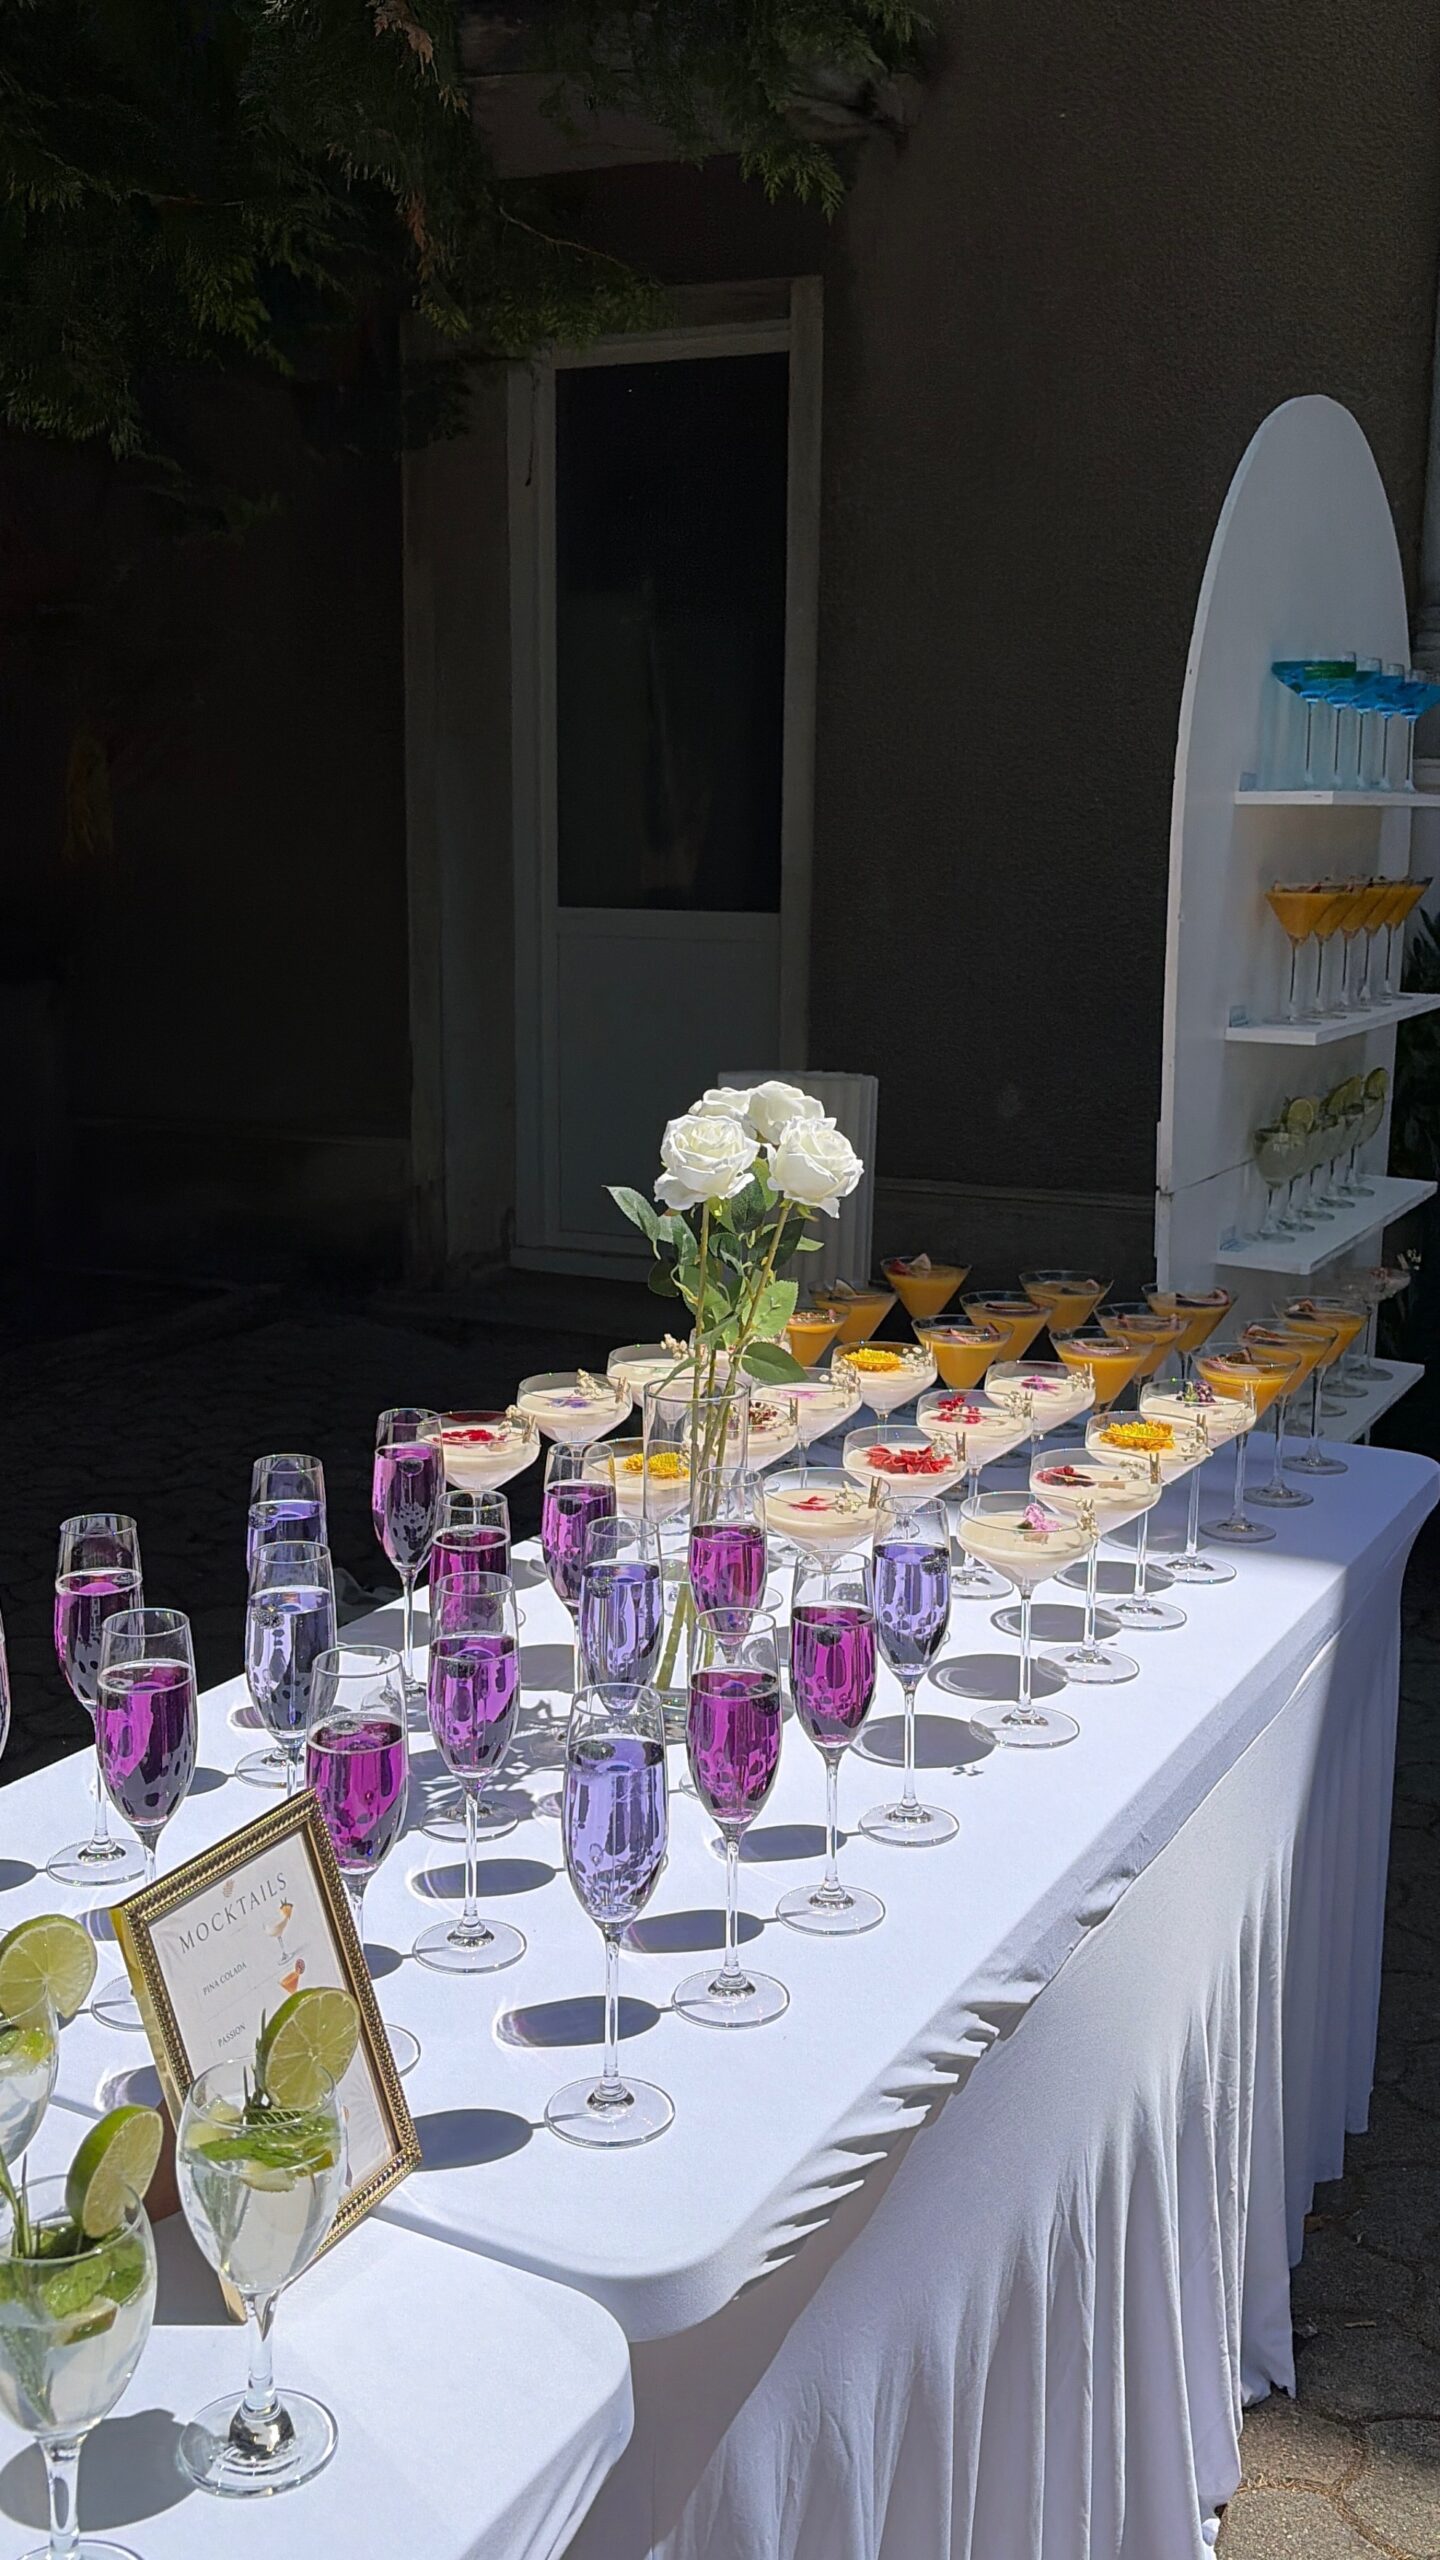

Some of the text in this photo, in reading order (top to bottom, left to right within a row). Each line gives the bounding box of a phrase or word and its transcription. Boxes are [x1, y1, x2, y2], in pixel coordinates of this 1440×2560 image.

[179, 1872, 287, 1954] MOCKTAILS
[220, 1962, 247, 1984] COLADA
[217, 2023, 246, 2048] PASSION
